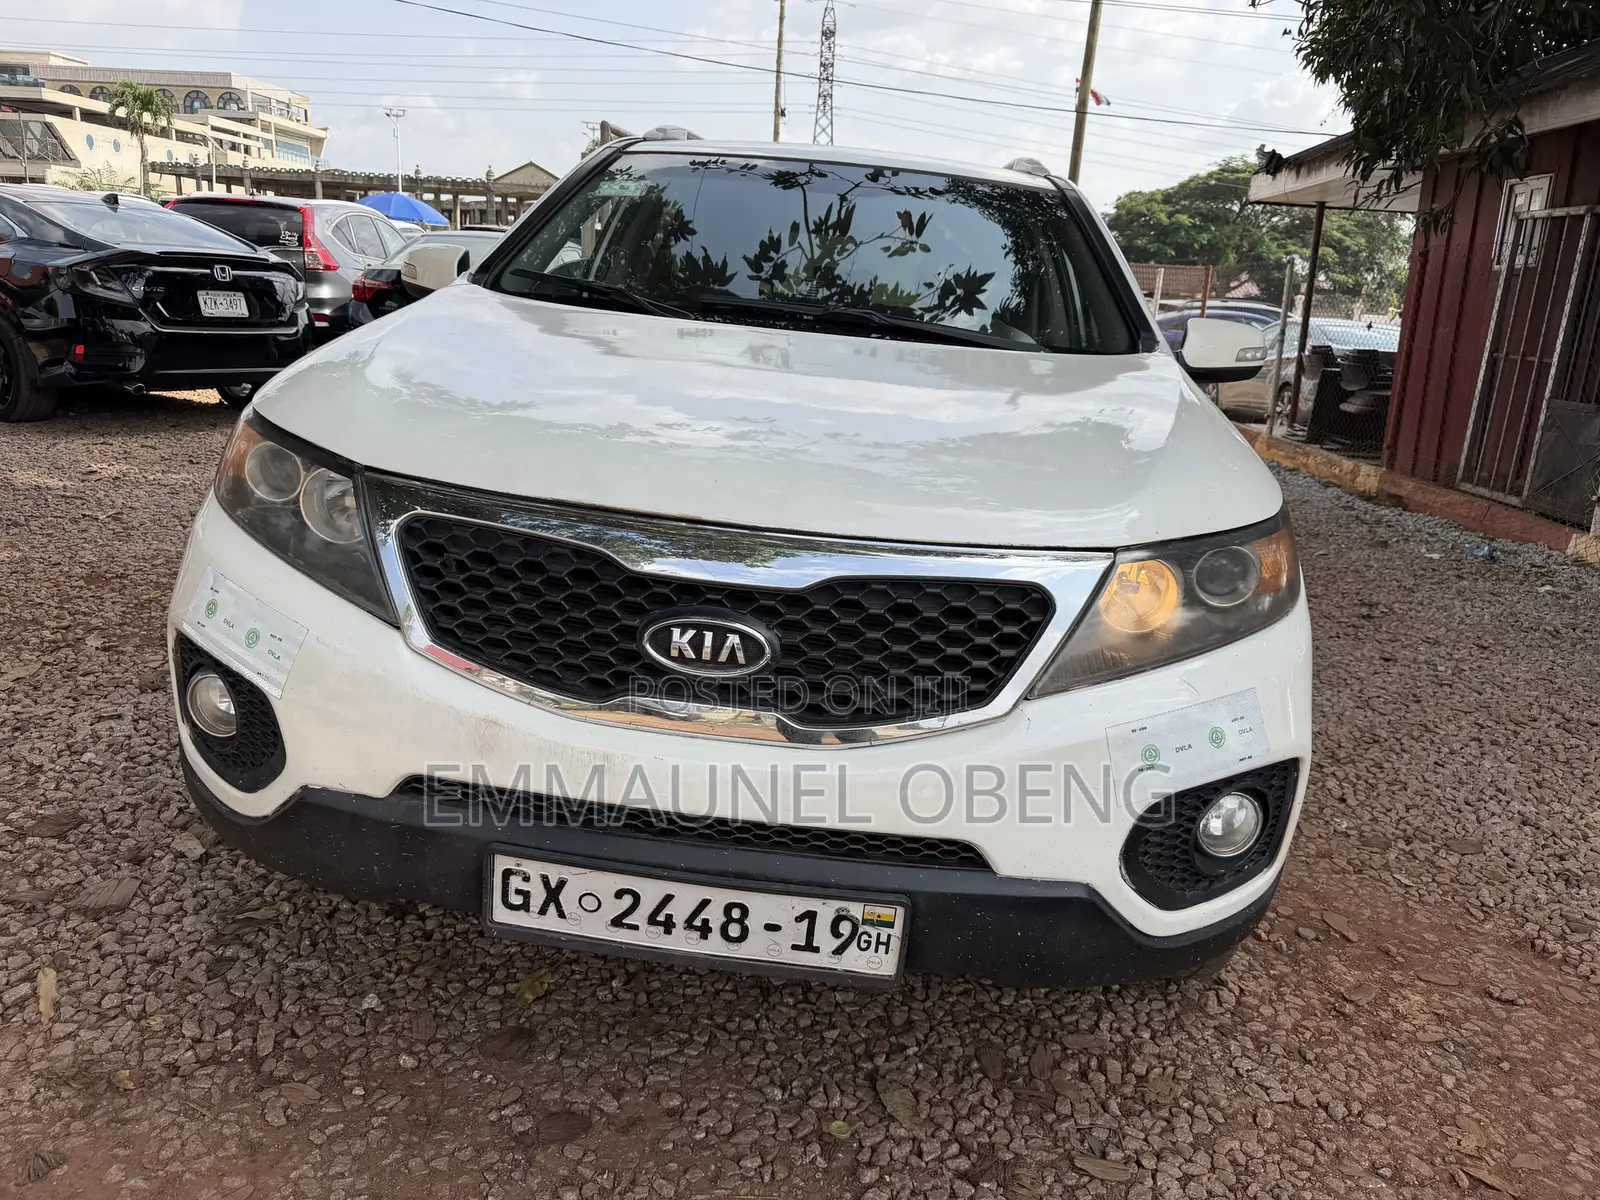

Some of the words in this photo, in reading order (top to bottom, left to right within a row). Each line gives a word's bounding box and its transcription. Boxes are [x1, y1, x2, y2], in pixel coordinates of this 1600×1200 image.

[223, 618, 235, 629] DVLA
[670, 627, 746, 665] KIA
[1238, 726, 1253, 735] DVLA
[1175, 743, 1193, 752] DVLA
[501, 867, 568, 919] GX
[856, 930, 892, 955] GH
